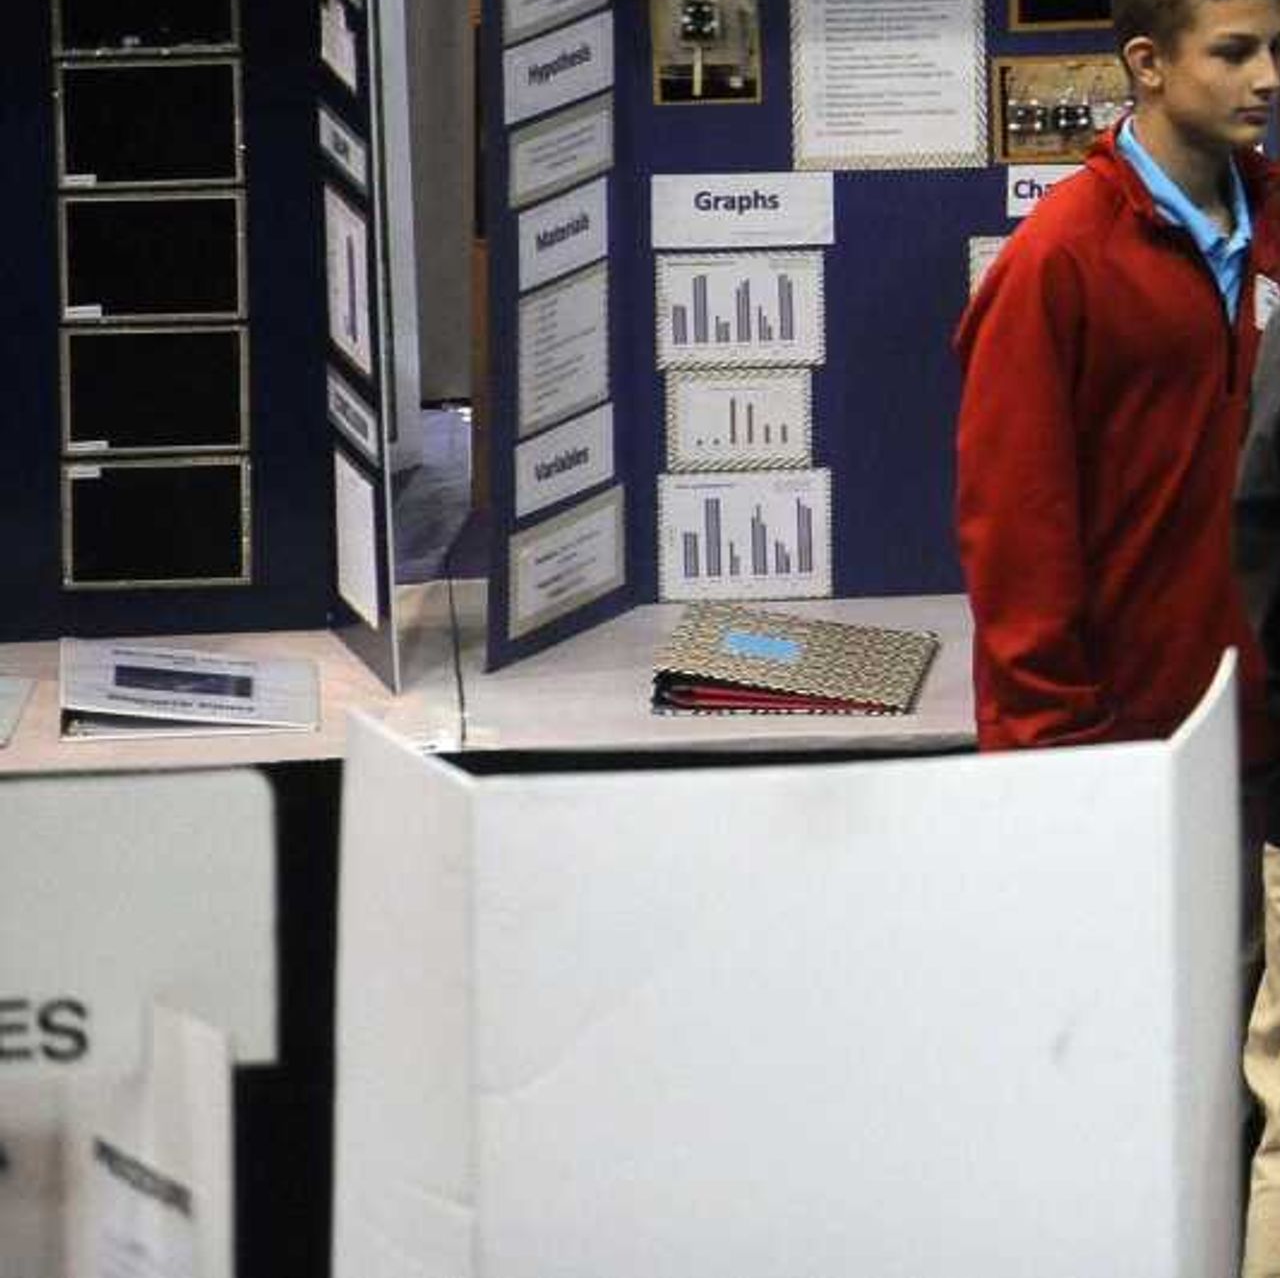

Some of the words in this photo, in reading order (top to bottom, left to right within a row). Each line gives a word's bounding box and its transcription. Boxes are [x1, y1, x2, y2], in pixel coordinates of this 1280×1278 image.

[527, 43, 592, 86] Hypothesis
[693, 188, 781, 216] Graphs
[535, 212, 590, 252] Materials
[533, 446, 590, 482] Variables
